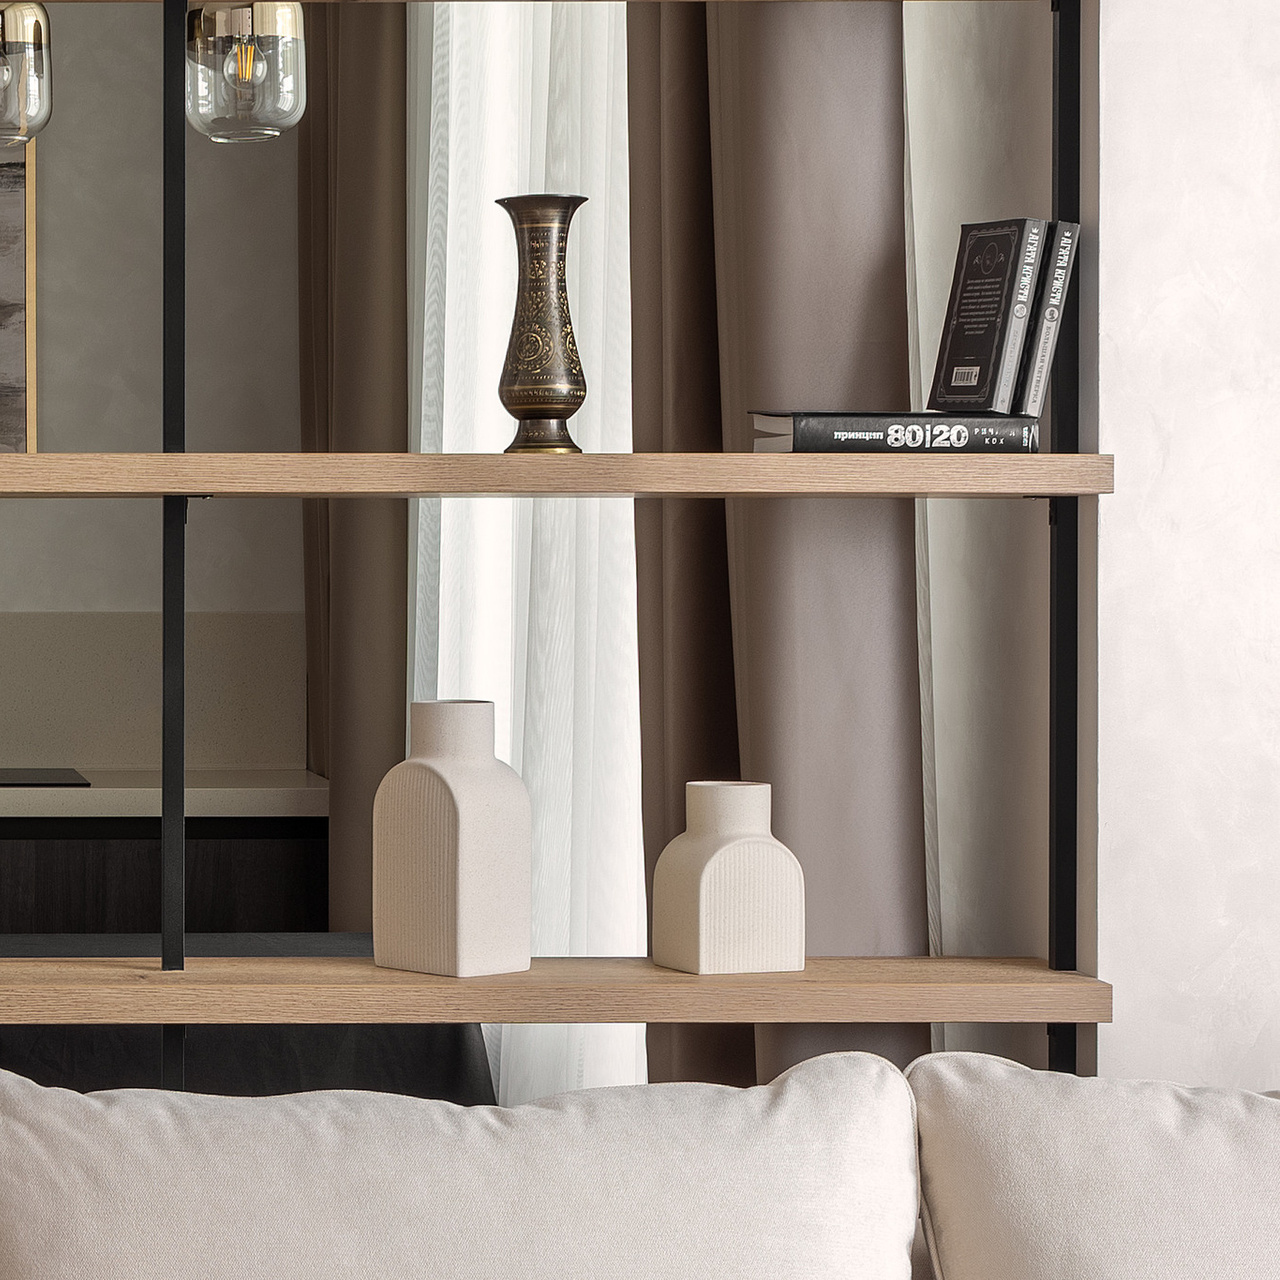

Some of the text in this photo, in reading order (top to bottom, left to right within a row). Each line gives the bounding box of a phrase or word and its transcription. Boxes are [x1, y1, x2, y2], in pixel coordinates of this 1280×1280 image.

[1017, 233, 1039, 302] АГАТА КРИСТИ
[1048, 237, 1072, 306] АГАТА КРИСТИ
[1031, 325, 1052, 404] БОЛЬШАЯ ЧЕТВЕРКА
[833, 430, 884, 442] принцип
[984, 437, 1005, 445] КОХ
